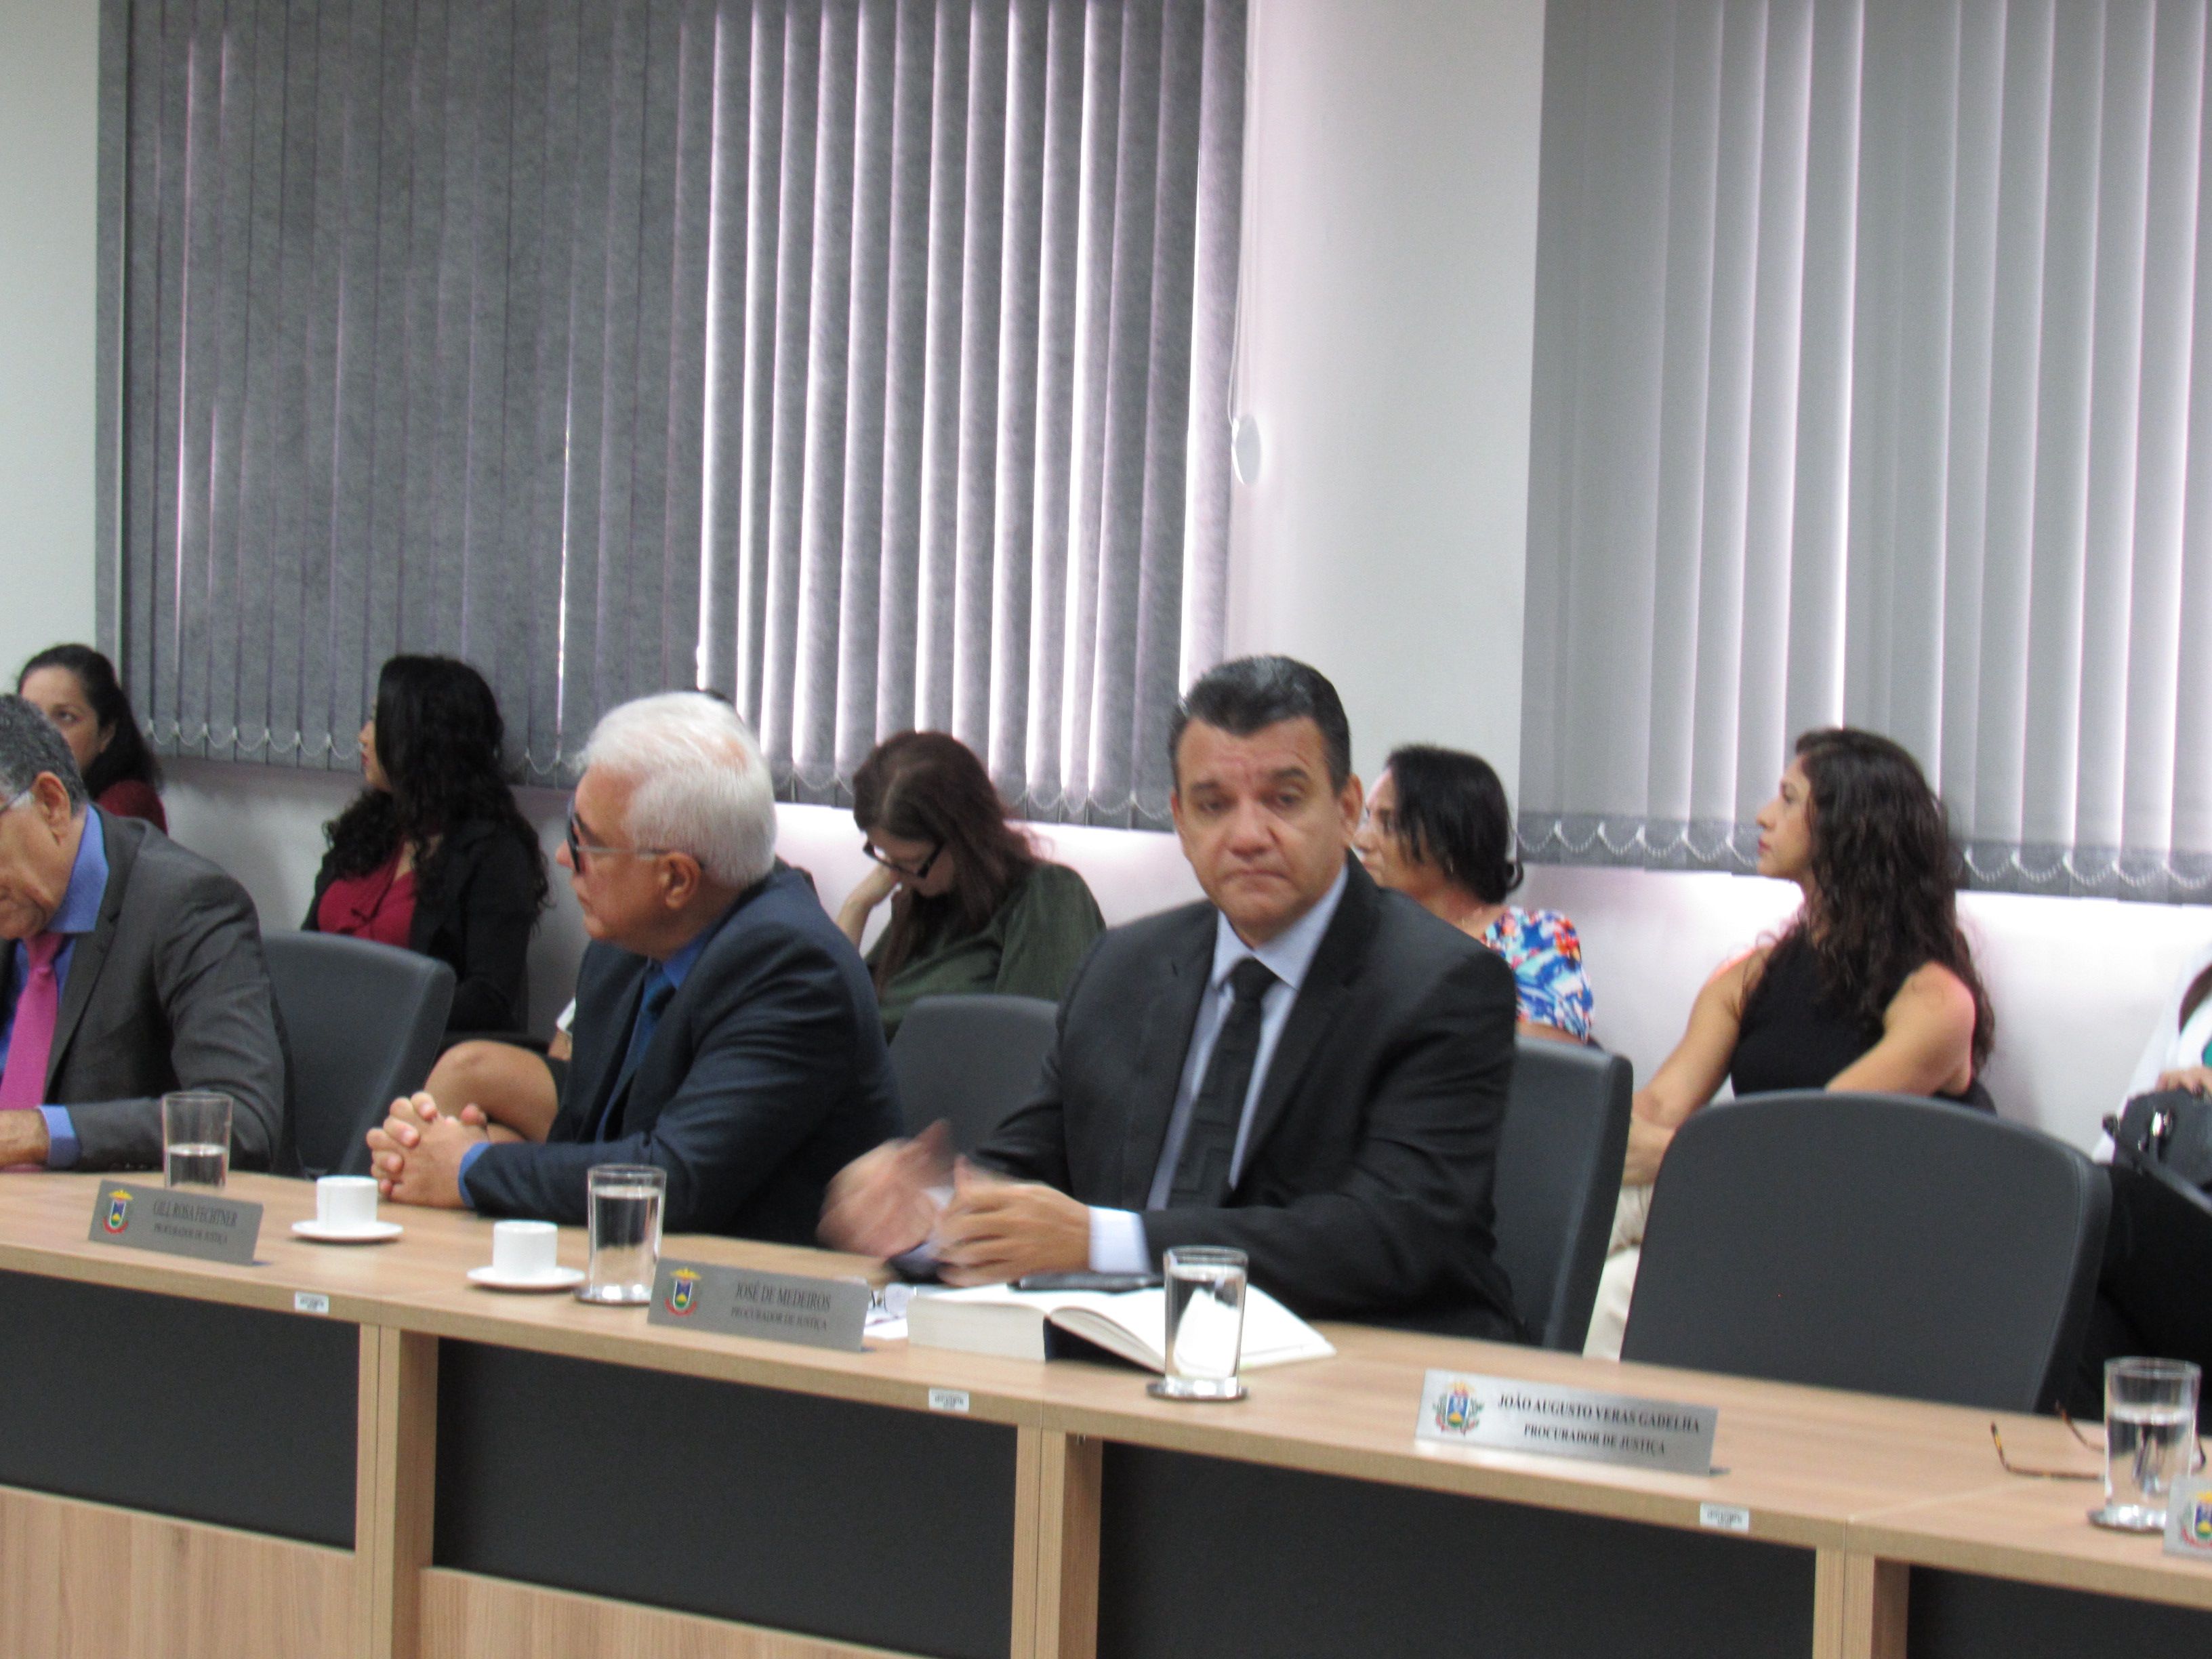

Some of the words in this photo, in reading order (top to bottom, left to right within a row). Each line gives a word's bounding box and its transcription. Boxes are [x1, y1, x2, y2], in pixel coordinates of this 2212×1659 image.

[736, 1280, 760, 1300] JOSÉ
[761, 1284, 774, 1303] DE
[778, 1286, 831, 1311] MEDEIROS
[731, 1306, 783, 1323] PROCURADOR
[783, 1313, 794, 1325] DE
[796, 1315, 827, 1331] JUSTIÇA
[1498, 1393, 1532, 1411] JOÃO
[1534, 1398, 1593, 1418] AUGUSTO
[1595, 1405, 1635, 1425] VERAS
[1639, 1411, 1699, 1433] GADELHA
[1524, 1423, 1599, 1447] PROCURADOR
[1602, 1433, 1618, 1447] DE
[1620, 1435, 1665, 1456] JUSTIÇA
